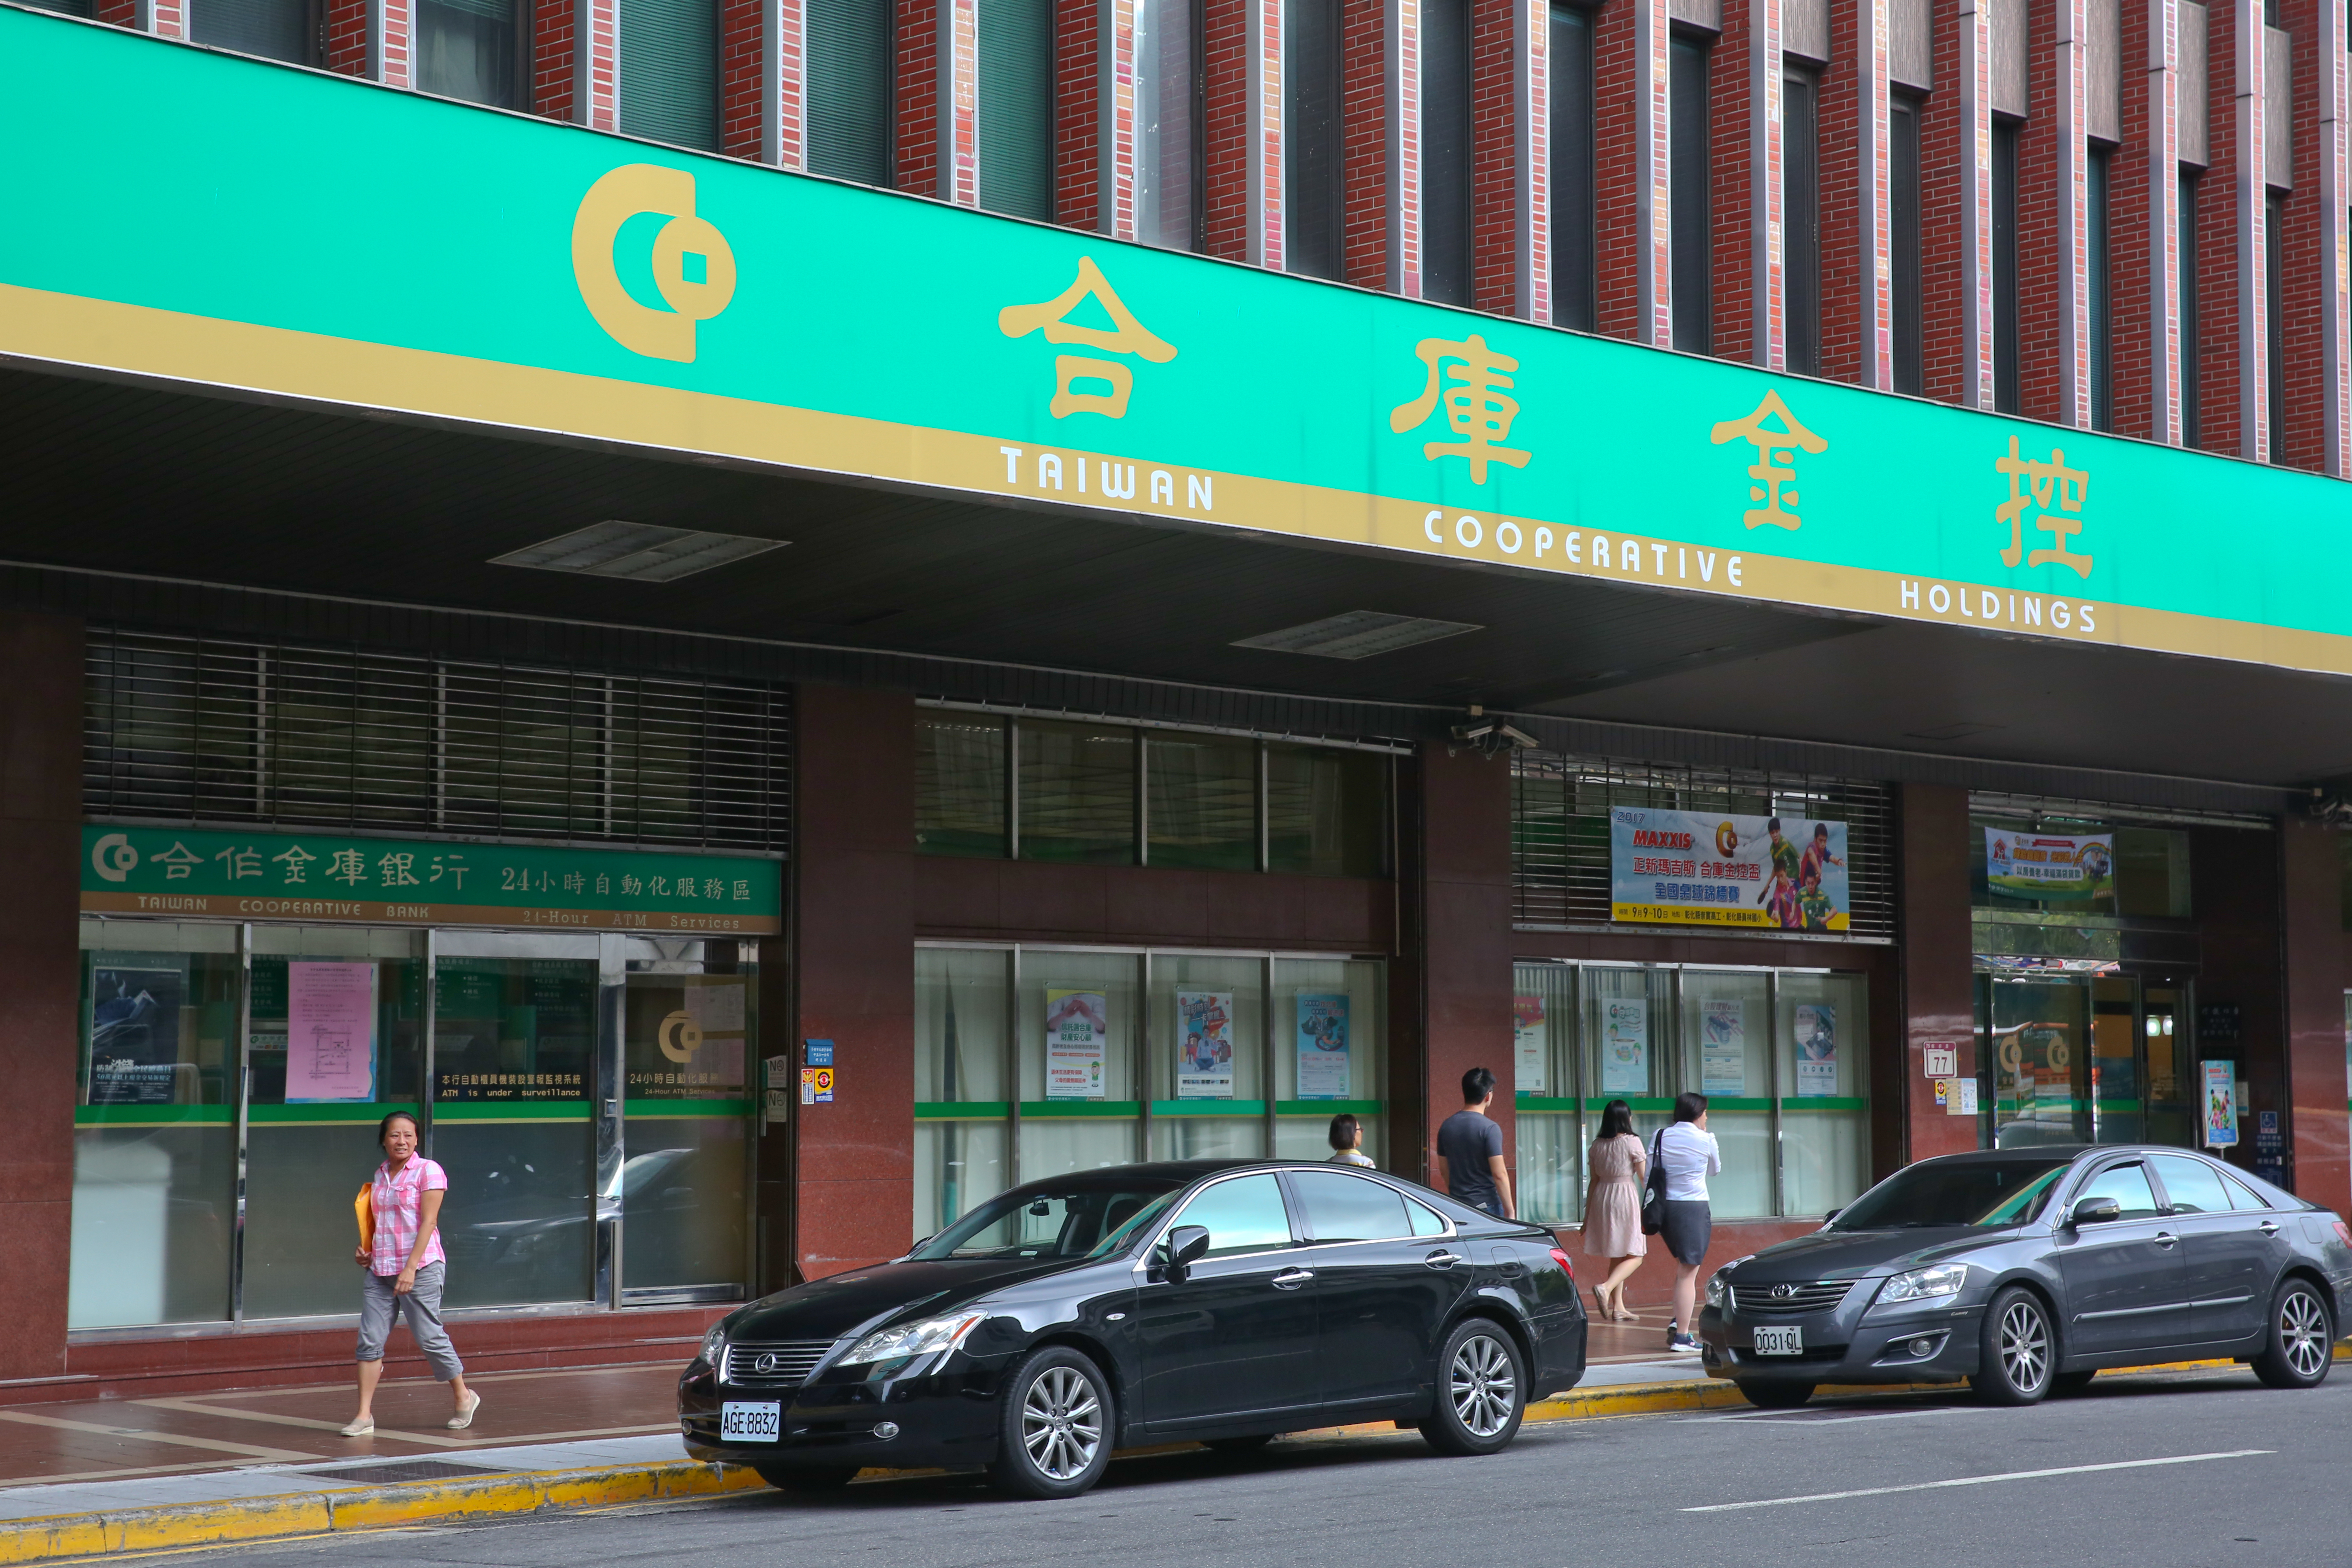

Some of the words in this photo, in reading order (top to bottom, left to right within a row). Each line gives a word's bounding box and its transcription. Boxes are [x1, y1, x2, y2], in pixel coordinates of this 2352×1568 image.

[998, 255, 2093, 580] 合庫金控
[1000, 446, 1212, 511] TAIWAN
[1424, 510, 1742, 587] COOPERATIVE
[1900, 580, 2095, 633] HOLDINGS
[1616, 811, 1646, 823] 2017
[1632, 829, 1692, 850] MAXXIS
[150, 841, 470, 890] 合作金庫銀行
[501, 867, 751, 901] 24小時自動化服務區
[1633, 857, 1695, 877] 正新瑪吉斯
[1700, 861, 1760, 880] 合庫金控盃
[1655, 882, 1740, 902] 全國桌球錦標賽
[138, 895, 207, 911] TAIWAN
[239, 899, 361, 916] COOPERATIVE
[387, 905, 429, 918] BANK
[523, 910, 589, 924] 24-Hour
[612, 913, 647, 926] ATM
[670, 915, 740, 928] Services
[1061, 1023, 1091, 1032] 信託選合庫
[1934, 1057, 1947, 1073] 77
[442, 1074, 581, 1085] 本行自動櫃員機裝設警報監視系統
